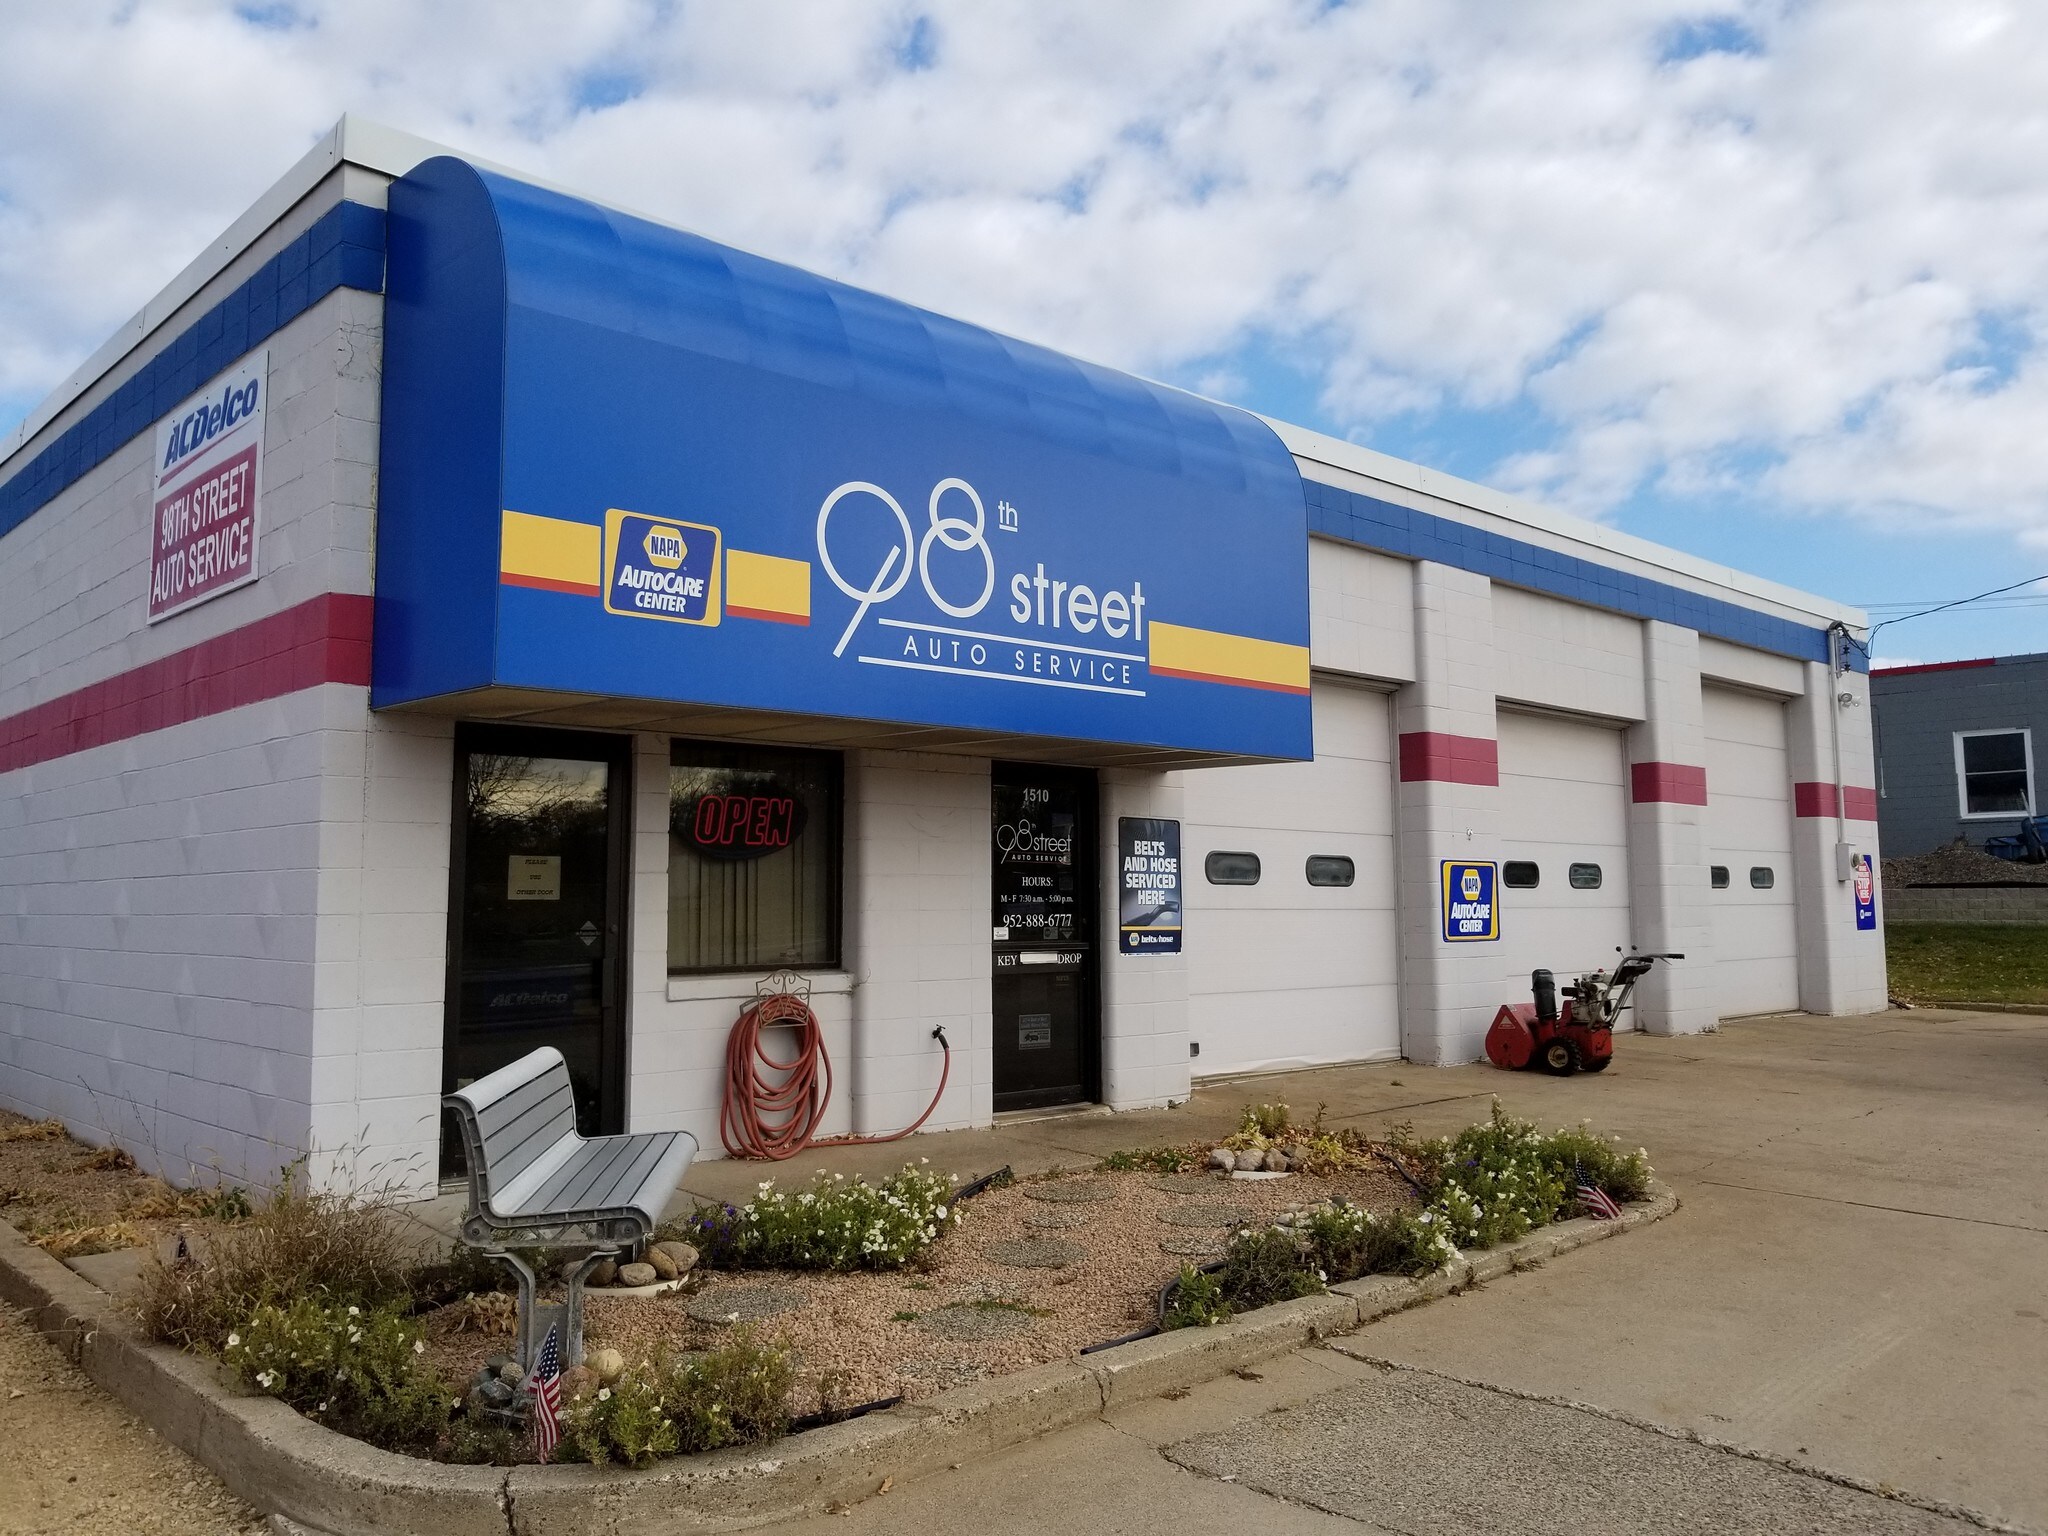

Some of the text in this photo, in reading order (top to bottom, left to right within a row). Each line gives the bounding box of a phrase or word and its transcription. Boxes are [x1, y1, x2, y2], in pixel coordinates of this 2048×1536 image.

[163, 378, 258, 470] ACDelco
[161, 460, 249, 551] 98TH STREET
[651, 535, 681, 558] NAPA
[151, 516, 250, 605] AUTO SERVICE
[635, 591, 687, 613] CENTER
[1010, 562, 1146, 642] street
[903, 635, 1131, 684] AUTO SERVICE
[1023, 787, 1049, 802] 1510
[694, 795, 794, 846] OPEN
[1033, 832, 1072, 853] street
[1134, 840, 1165, 857] BELTS
[1035, 855, 1067, 863] SERVICE
[1124, 857, 1177, 873] AND HOSE
[1022, 877, 1053, 886] HOURS:
[1125, 873, 1176, 889] SERVICED
[1464, 878, 1479, 892] NAPA
[1001, 895, 1008, 903] M
[1138, 890, 1165, 905] HERE
[1003, 914, 1072, 928] 952-888-6777
[1459, 920, 1483, 932] CENTER
[997, 953, 1082, 966] KEY DROP
